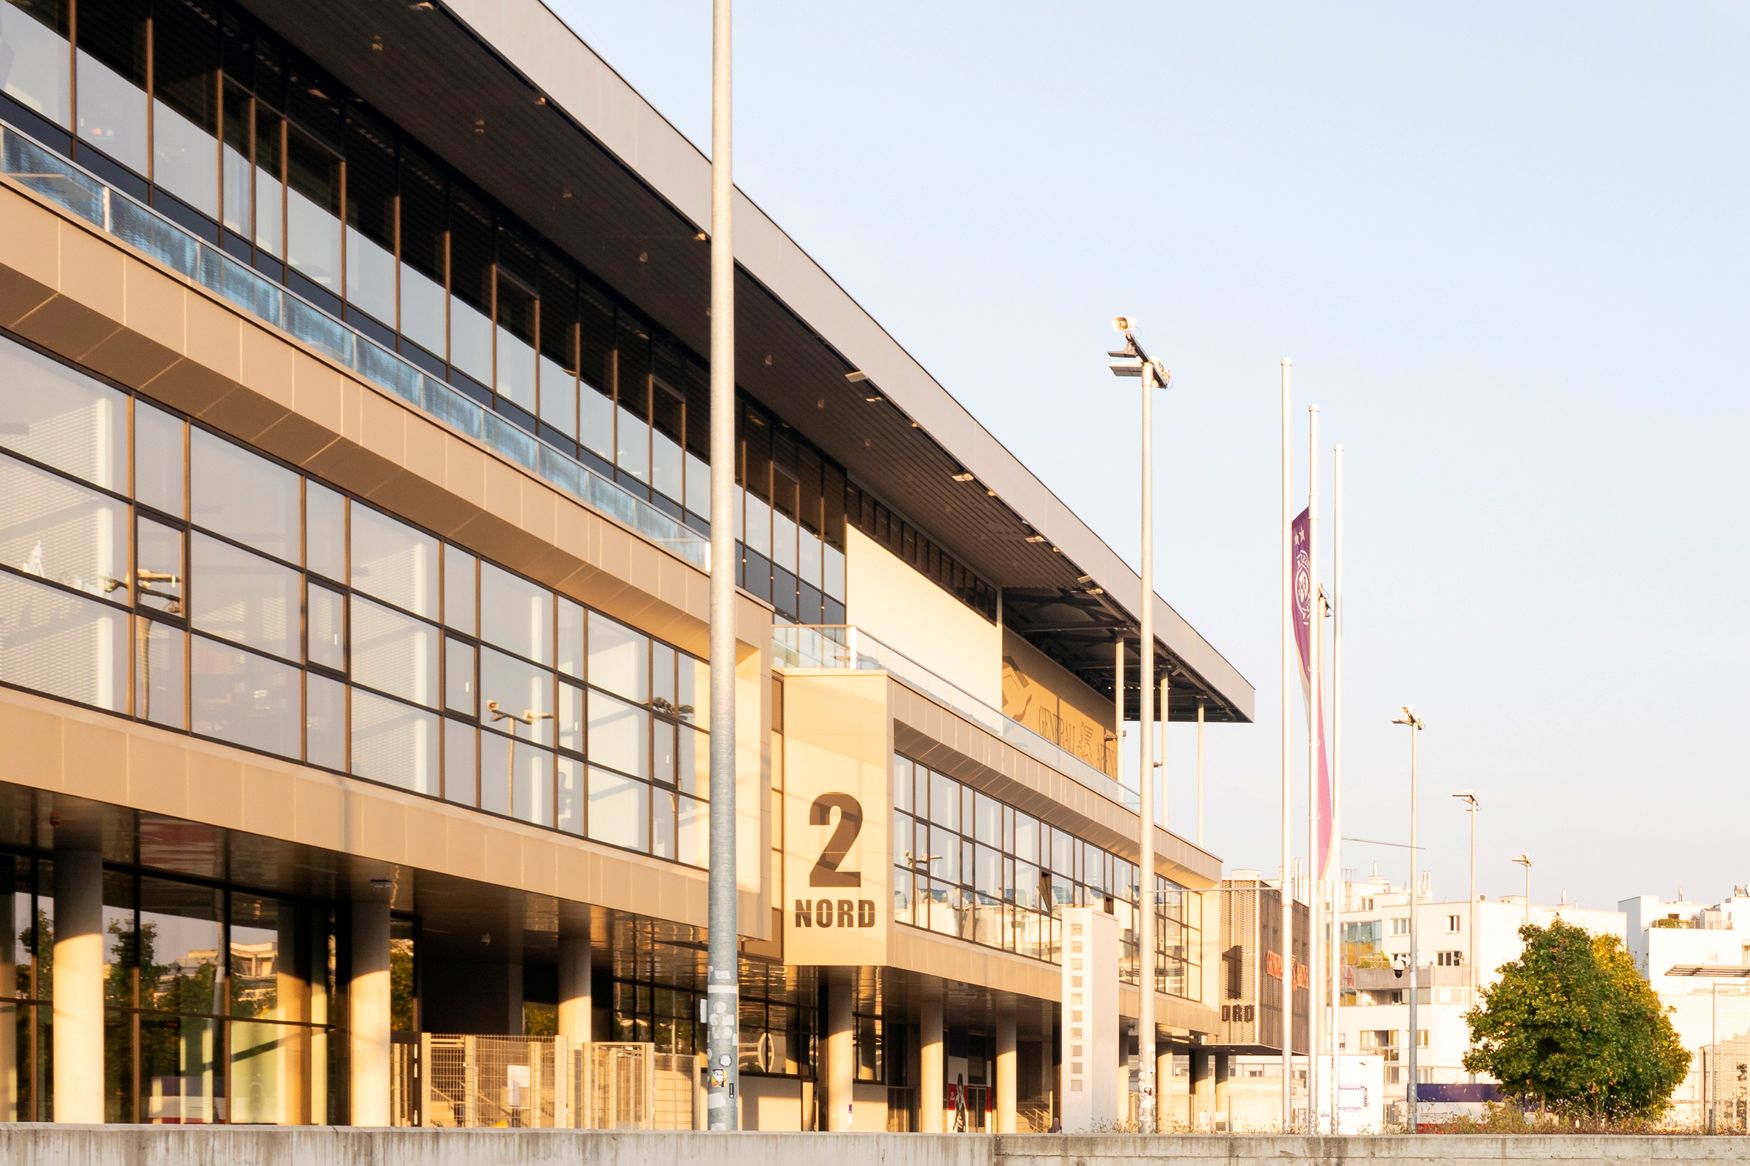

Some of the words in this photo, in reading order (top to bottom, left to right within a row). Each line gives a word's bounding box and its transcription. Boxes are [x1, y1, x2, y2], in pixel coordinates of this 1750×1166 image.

[809, 791, 863, 888] 2
[795, 899, 876, 928] NORD
[1221, 945, 1242, 1000] 1
[1221, 1004, 1255, 1023] ORD
